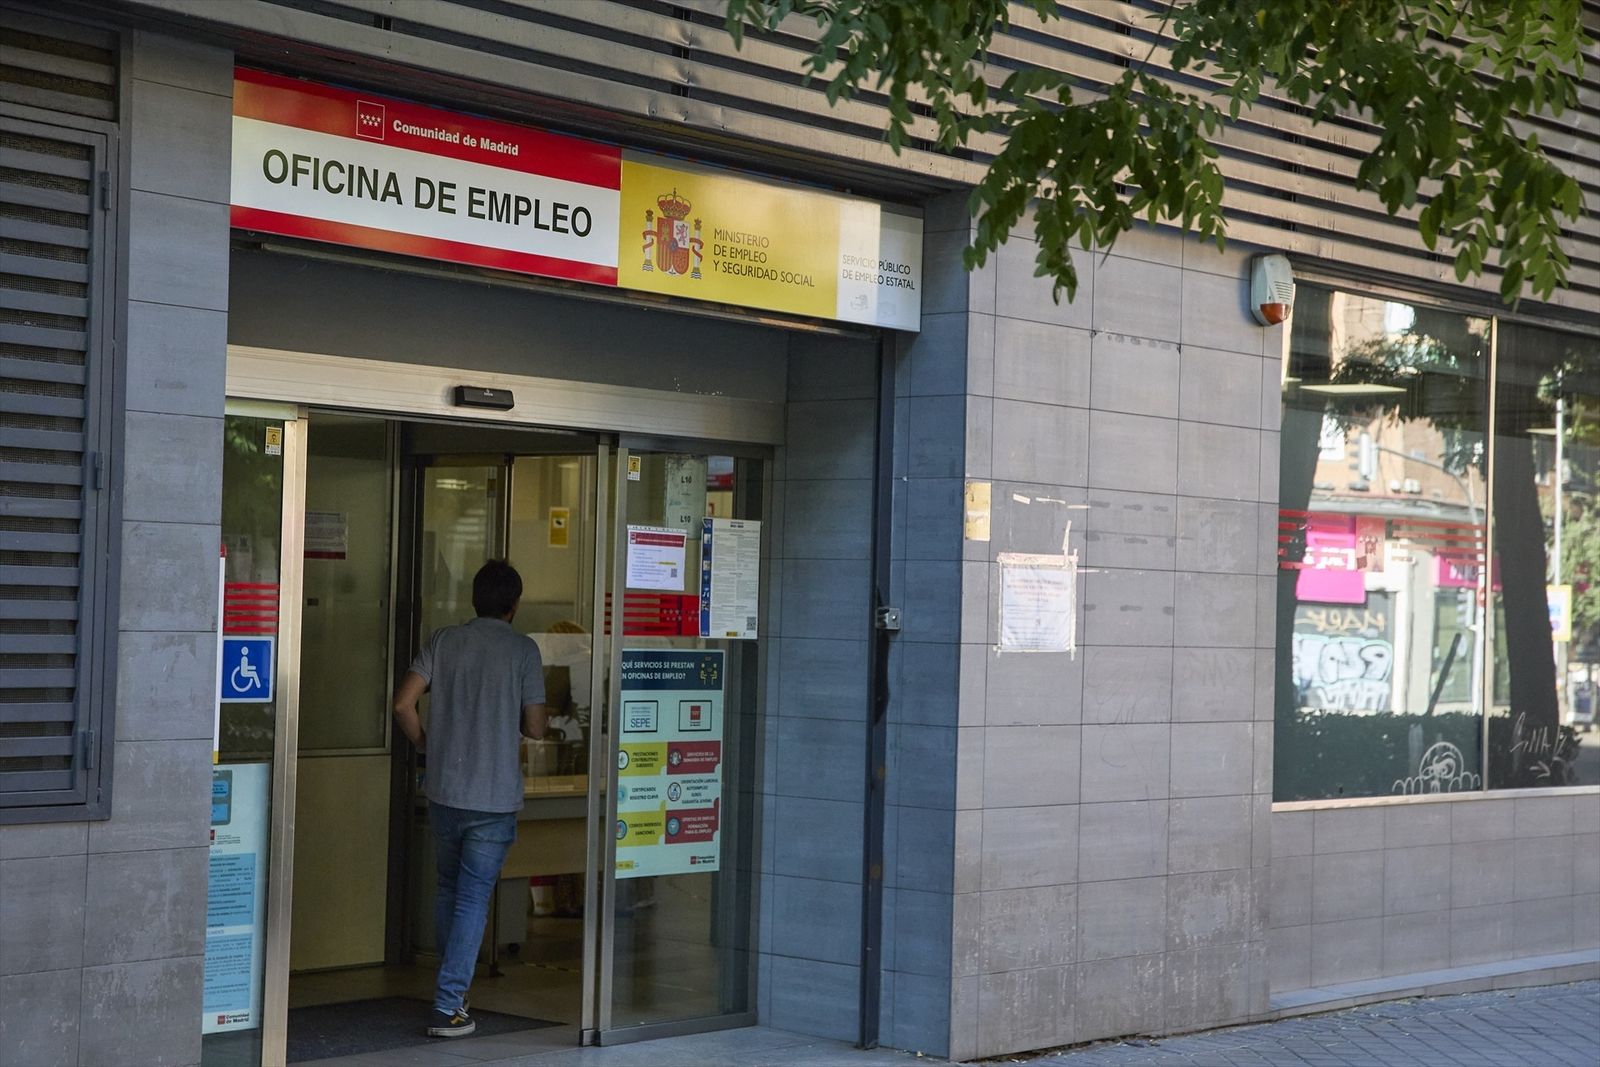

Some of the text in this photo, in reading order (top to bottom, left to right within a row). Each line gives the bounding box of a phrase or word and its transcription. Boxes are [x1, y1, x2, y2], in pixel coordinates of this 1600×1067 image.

[393, 119, 519, 156] Comunidad de Madrid
[263, 149, 593, 238] OFICINA DE EMPLEO
[714, 228, 769, 248] MINISTERIO
[714, 244, 767, 264] DE EMPLEO
[713, 261, 815, 287] Y SEGURIDAD SOCIAL
[842, 255, 911, 275] SERVICIO PÚBLICO
[842, 269, 915, 290] DE EMPLEO ESTATAL
[634, 661, 662, 669] SERVICIOS
[628, 672, 653, 680] OFICINAS
[662, 672, 686, 680] EMPLEO?
[630, 717, 651, 728] SEPE
